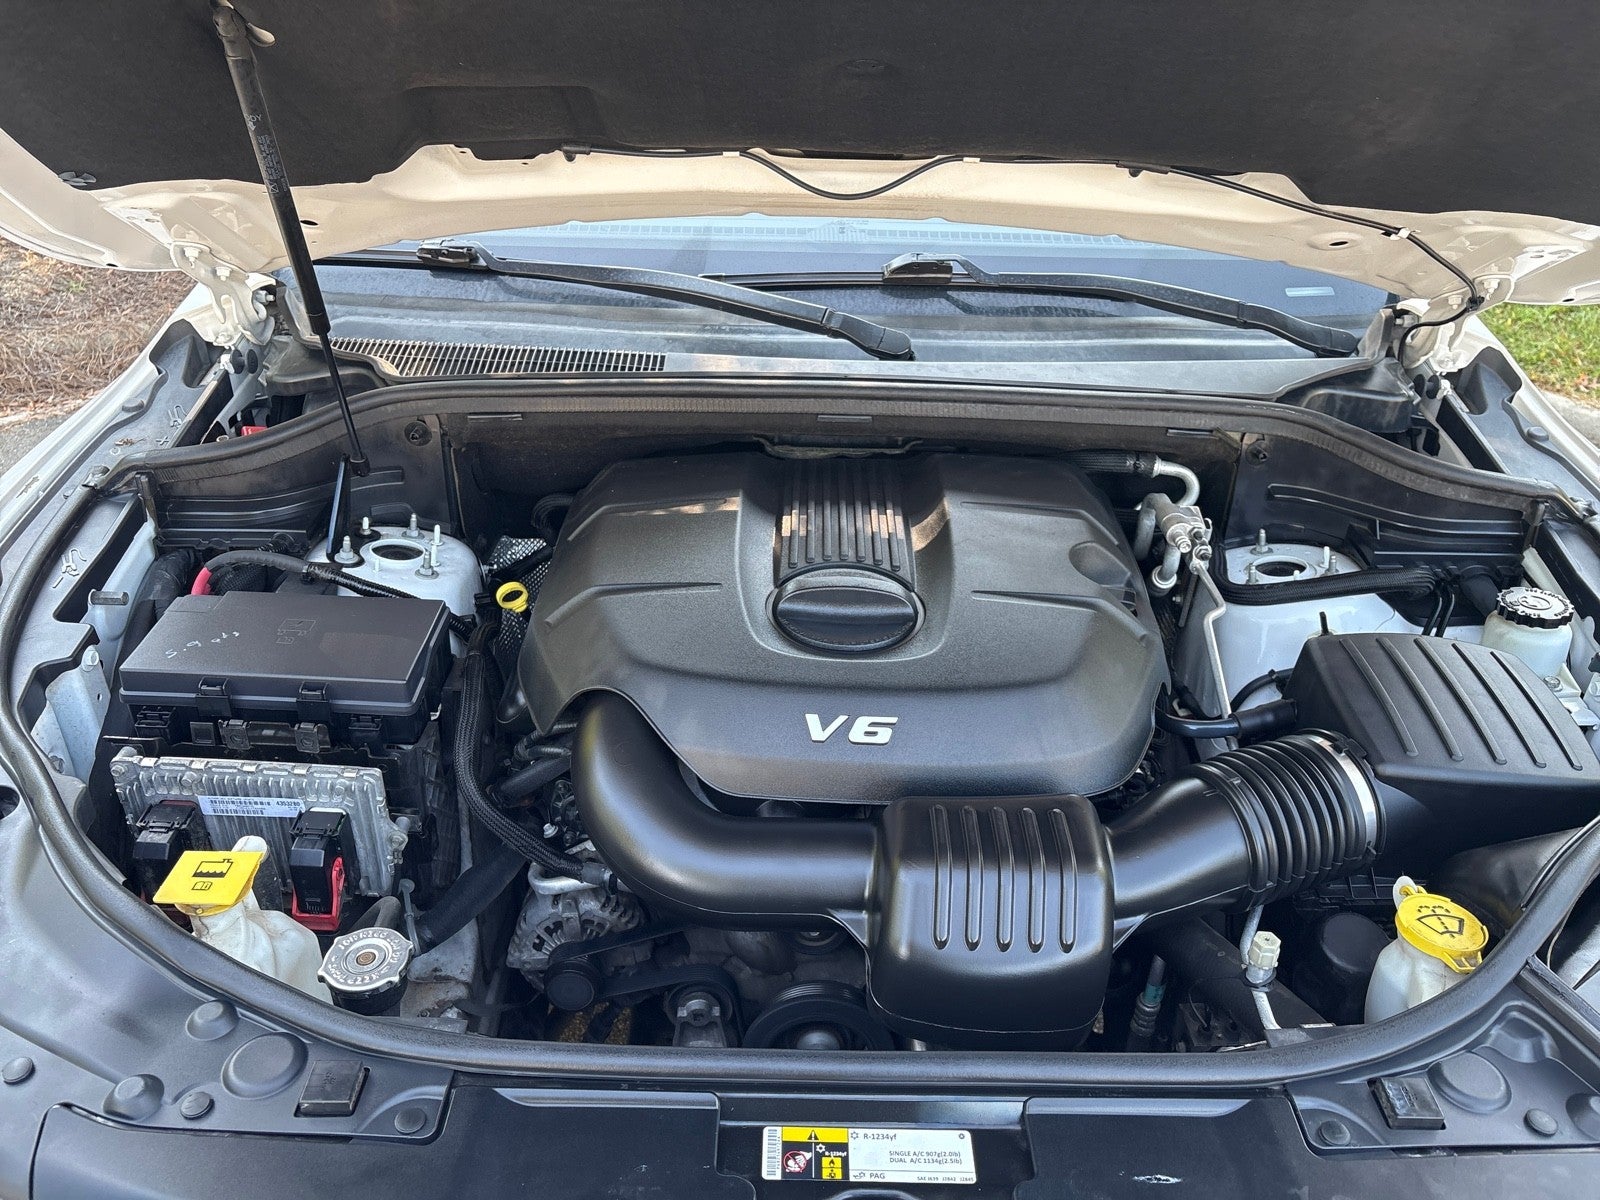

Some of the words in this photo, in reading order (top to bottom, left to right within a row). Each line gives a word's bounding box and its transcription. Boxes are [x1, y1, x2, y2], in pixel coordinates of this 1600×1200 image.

[804, 713, 899, 745] V6
[863, 1133, 897, 1141] R-1234yf
[869, 1172, 886, 1180] PAG
